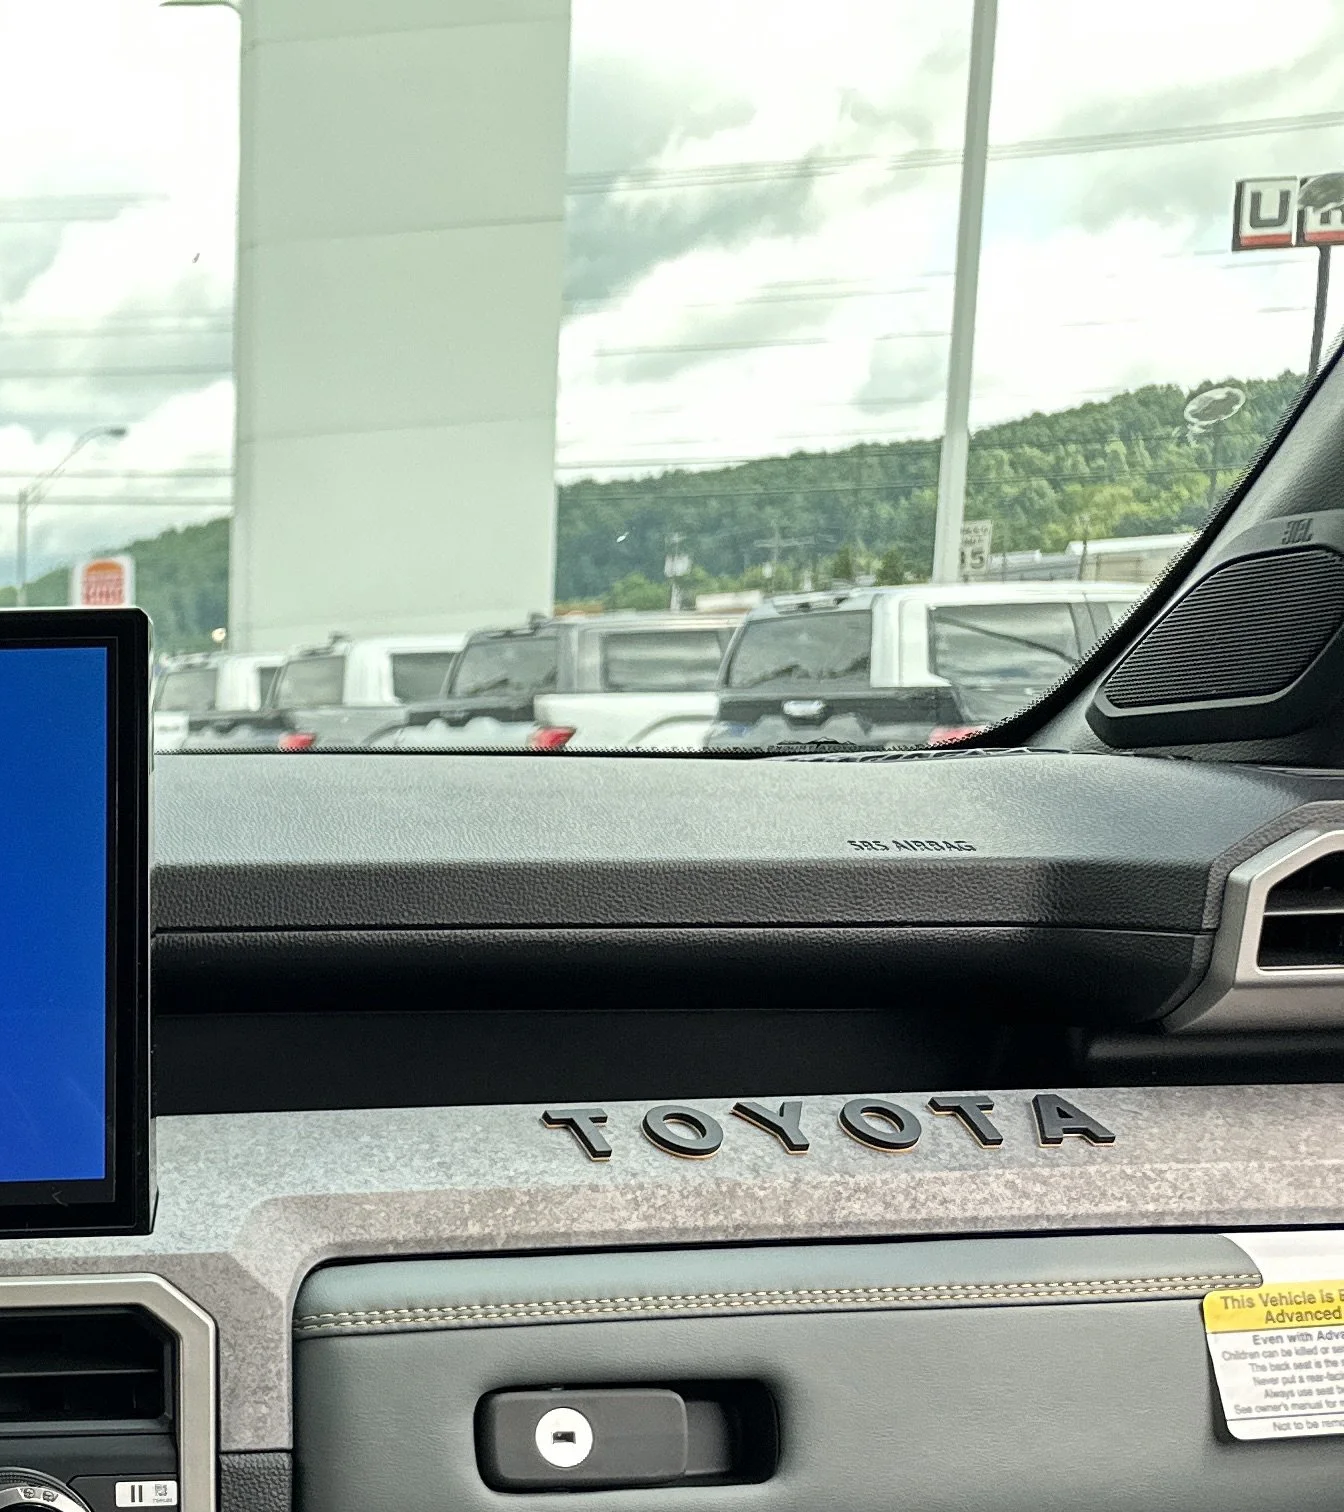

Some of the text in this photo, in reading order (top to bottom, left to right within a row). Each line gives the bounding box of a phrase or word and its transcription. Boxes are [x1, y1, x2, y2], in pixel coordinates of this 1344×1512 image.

[539, 1093, 1117, 1162] TOYOTA
[1220, 1294, 1255, 1310] This
[1258, 1290, 1317, 1307] Vehicle
[1320, 1289, 1335, 1304] is
[1265, 1308, 1343, 1324] Advanced
[1252, 1331, 1313, 1345] Even with
